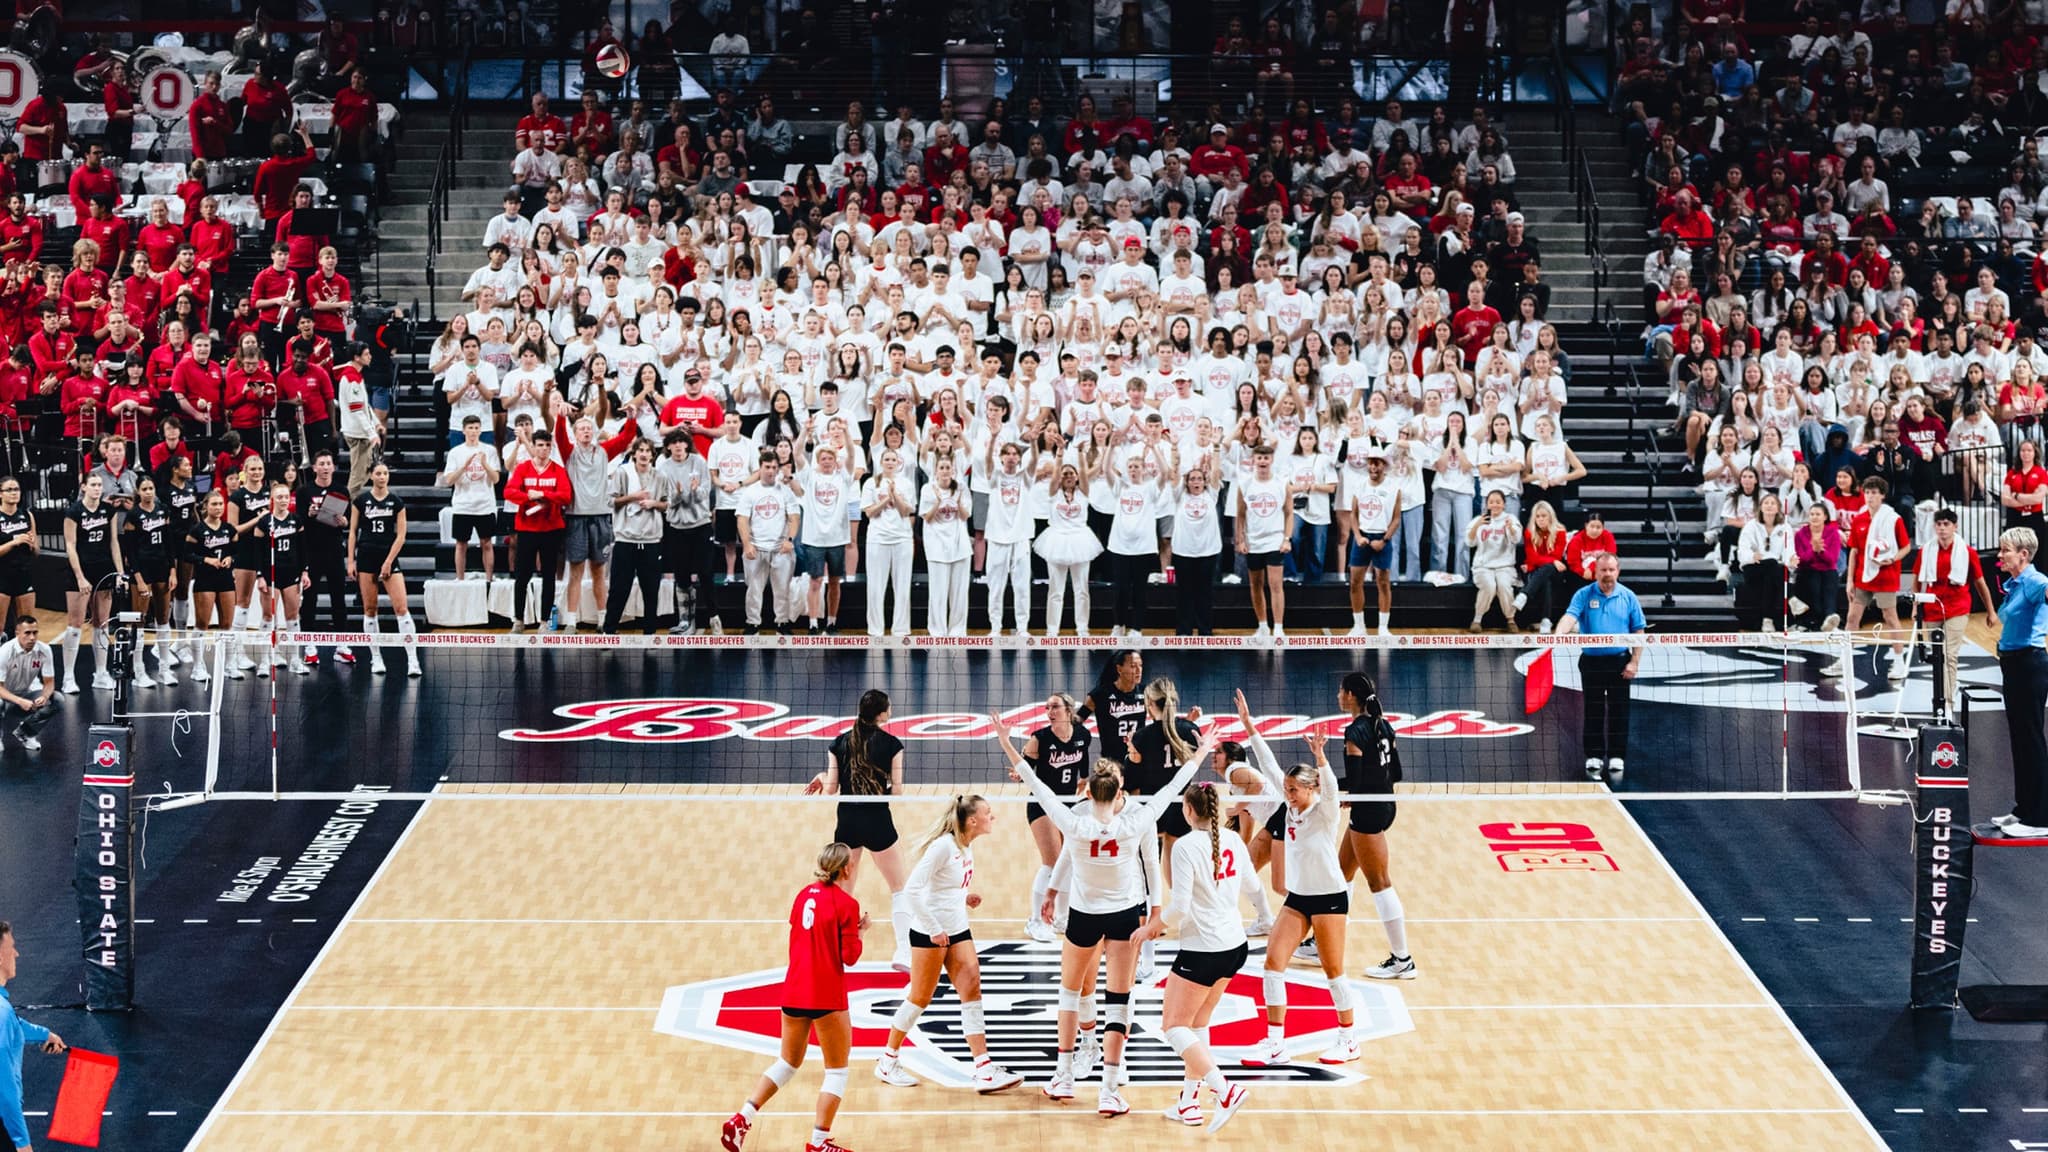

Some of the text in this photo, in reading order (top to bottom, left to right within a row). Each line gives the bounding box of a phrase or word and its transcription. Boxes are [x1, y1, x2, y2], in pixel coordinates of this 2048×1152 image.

[153, 72, 181, 110] O
[371, 520, 384, 533] 13
[88, 530, 104, 542] 22
[151, 531, 162, 544] 21
[277, 539, 290, 552] 10
[294, 634, 312, 643] OHIO
[313, 634, 334, 643] STATE
[335, 634, 371, 643] BUCKEYES
[418, 635, 436, 644] OHIO
[437, 635, 457, 644] STATE
[460, 635, 496, 644] BUCKEYES
[544, 635, 561, 645] OHIO
[563, 635, 583, 645] STATE
[585, 635, 620, 645] BUCKEYES
[668, 636, 686, 645] OHIO
[687, 636, 707, 645] STATE
[709, 636, 745, 645] BUCKEYES
[792, 636, 810, 646] OHIO
[811, 636, 831, 646] STATE
[833, 636, 869, 646] BUCKEYES
[916, 636, 934, 646] OHIO
[935, 636, 956, 646] STATE
[958, 636, 993, 646] BUCKEYES
[1041, 636, 1059, 646] OHIO
[1060, 636, 1080, 646] STATE
[1082, 636, 1117, 646] BUCKEYES
[1165, 637, 1183, 646] OHIO
[1184, 637, 1204, 646] STATE
[1206, 637, 1242, 646] BUCKEYES
[1289, 637, 1307, 646] OHIO
[1308, 637, 1329, 646] STATE
[1331, 637, 1365, 646] BUCKEYES
[1413, 636, 1431, 646] OHIO
[1432, 636, 1453, 646] STATE
[1455, 636, 1489, 646] BUCKEYES
[1537, 635, 1612, 645] OHIO STATE BUCKEYES
[1660, 635, 1678, 644] OHIO
[1680, 635, 1700, 644] STATE
[1702, 635, 1737, 644] BUCKEYES
[1109, 701, 1146, 719] Nebrask
[1118, 720, 1139, 737] 27
[1061, 769, 1072, 783] 6
[267, 784, 391, 902] O'SHAUGHNESSY COT
[1089, 838, 1120, 858] 14
[98, 793, 118, 967] OHIO STATE
[1929, 807, 1951, 954] BUCKEYES
[802, 898, 817, 930] 6
